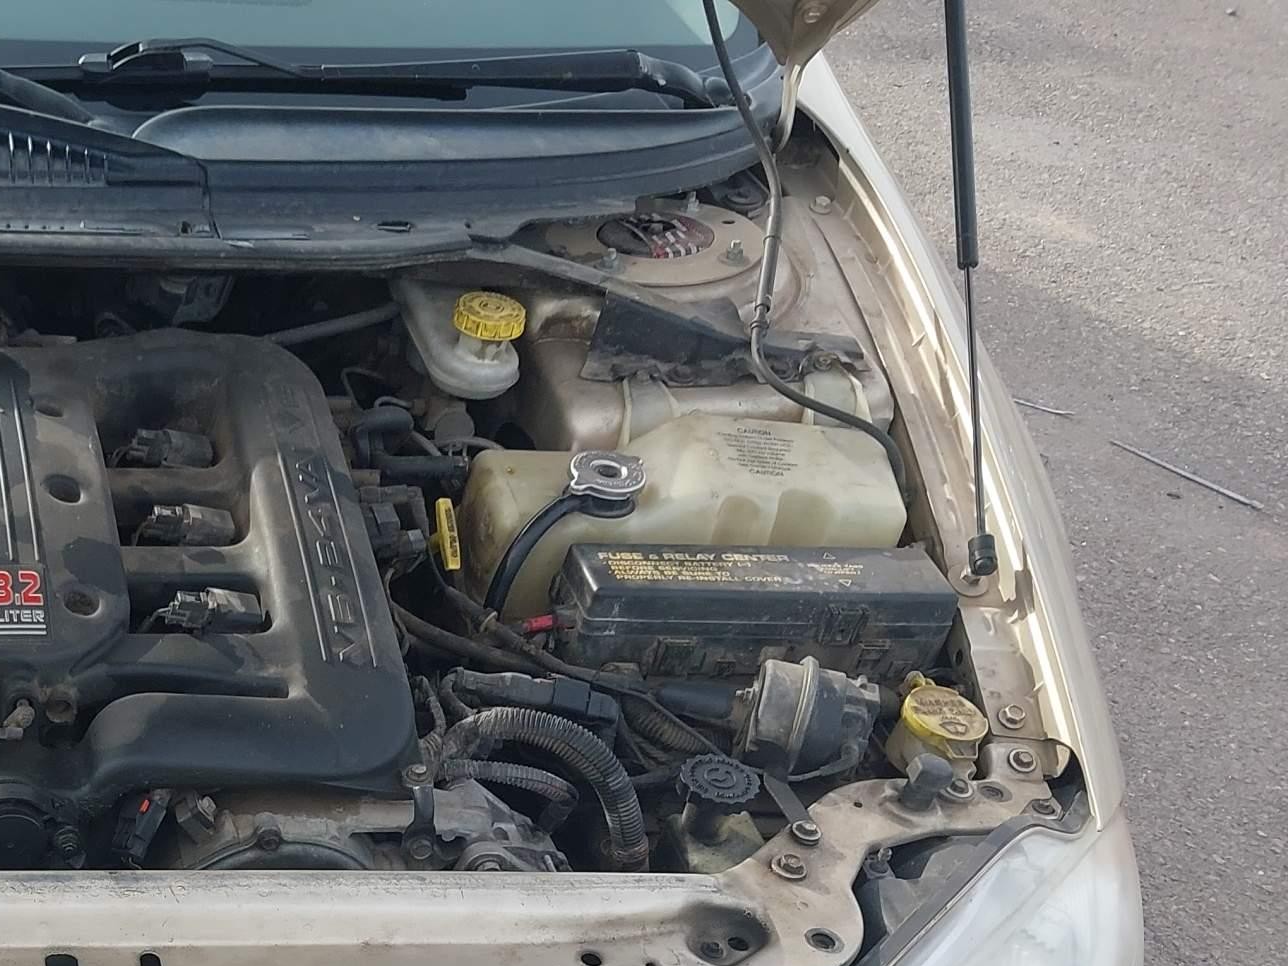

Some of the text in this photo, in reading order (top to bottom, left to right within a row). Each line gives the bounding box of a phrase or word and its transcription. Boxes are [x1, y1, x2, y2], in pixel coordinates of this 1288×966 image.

[597, 552, 644, 560] FUSE
[662, 552, 715, 561] RELAY
[721, 553, 790, 562] CENTER
